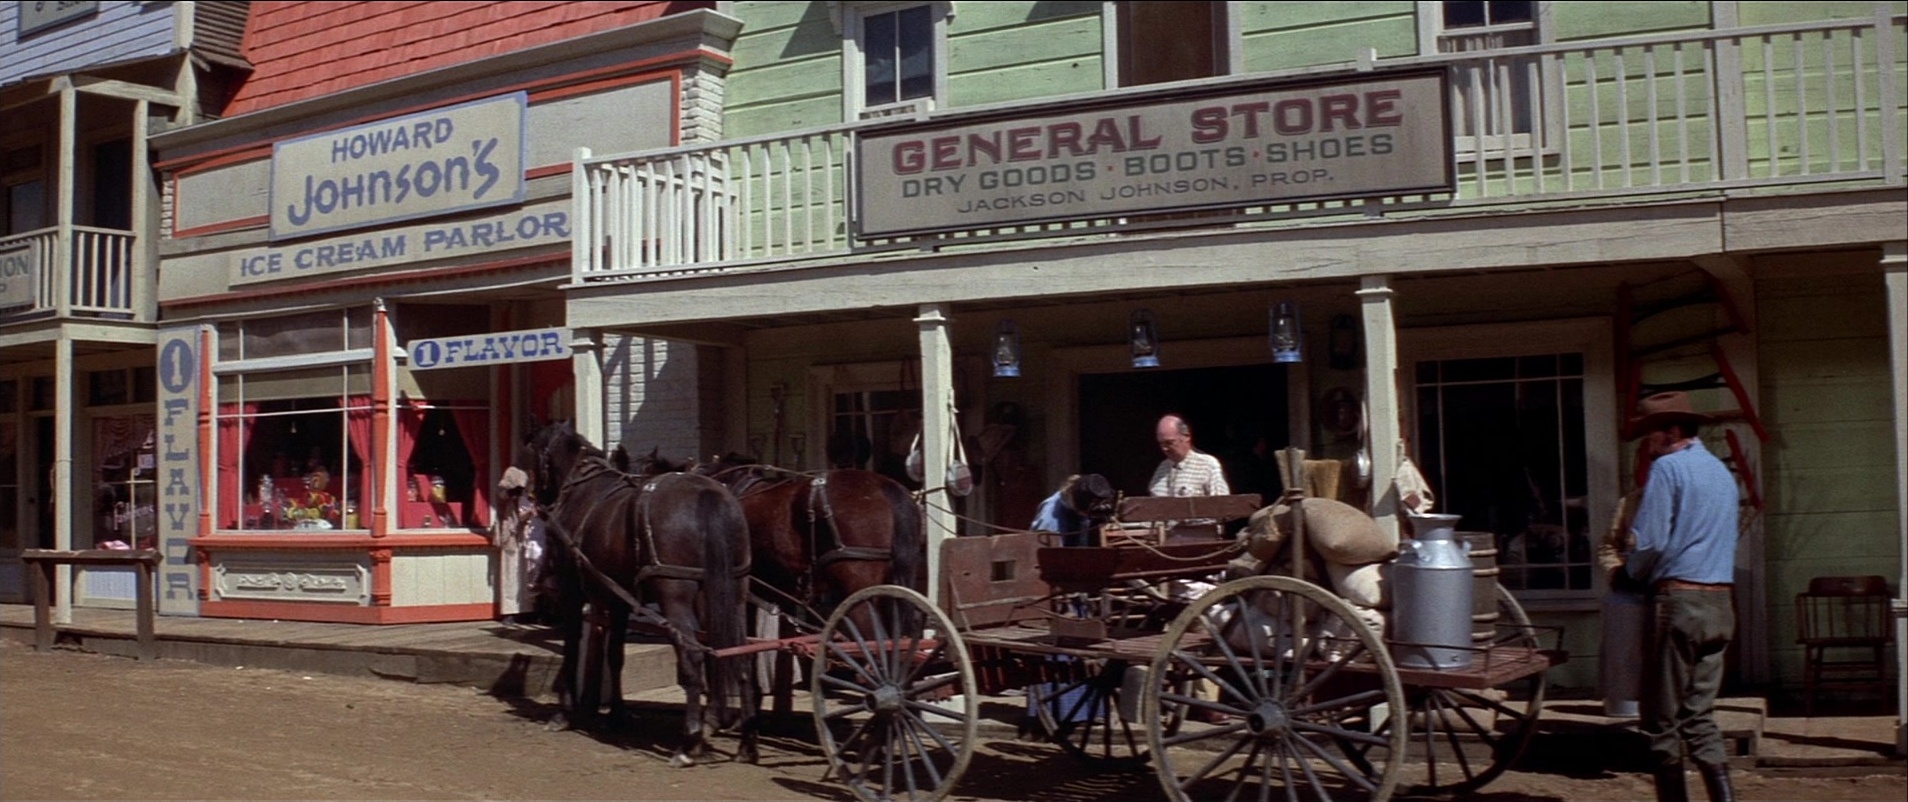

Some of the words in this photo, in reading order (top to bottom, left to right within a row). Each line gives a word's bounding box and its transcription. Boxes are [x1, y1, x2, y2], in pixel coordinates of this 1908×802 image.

[331, 117, 453, 163] HOWARD
[892, 115, 1162, 176] GENERAL
[1190, 89, 1403, 144] STORE
[902, 174, 966, 198] DRY
[979, 161, 1096, 191] GOODS
[1124, 146, 1246, 176] BOOTS
[1266, 134, 1394, 163] SHOES
[957, 190, 1086, 214] JACKSON
[1251, 168, 1334, 188] PROP.
[240, 253, 282, 277] ICE
[293, 236, 407, 270] CREAM
[424, 211, 571, 252] PARLOR
[445, 332, 563, 363] FLAVOR
[164, 398, 194, 601] FLAVOR
